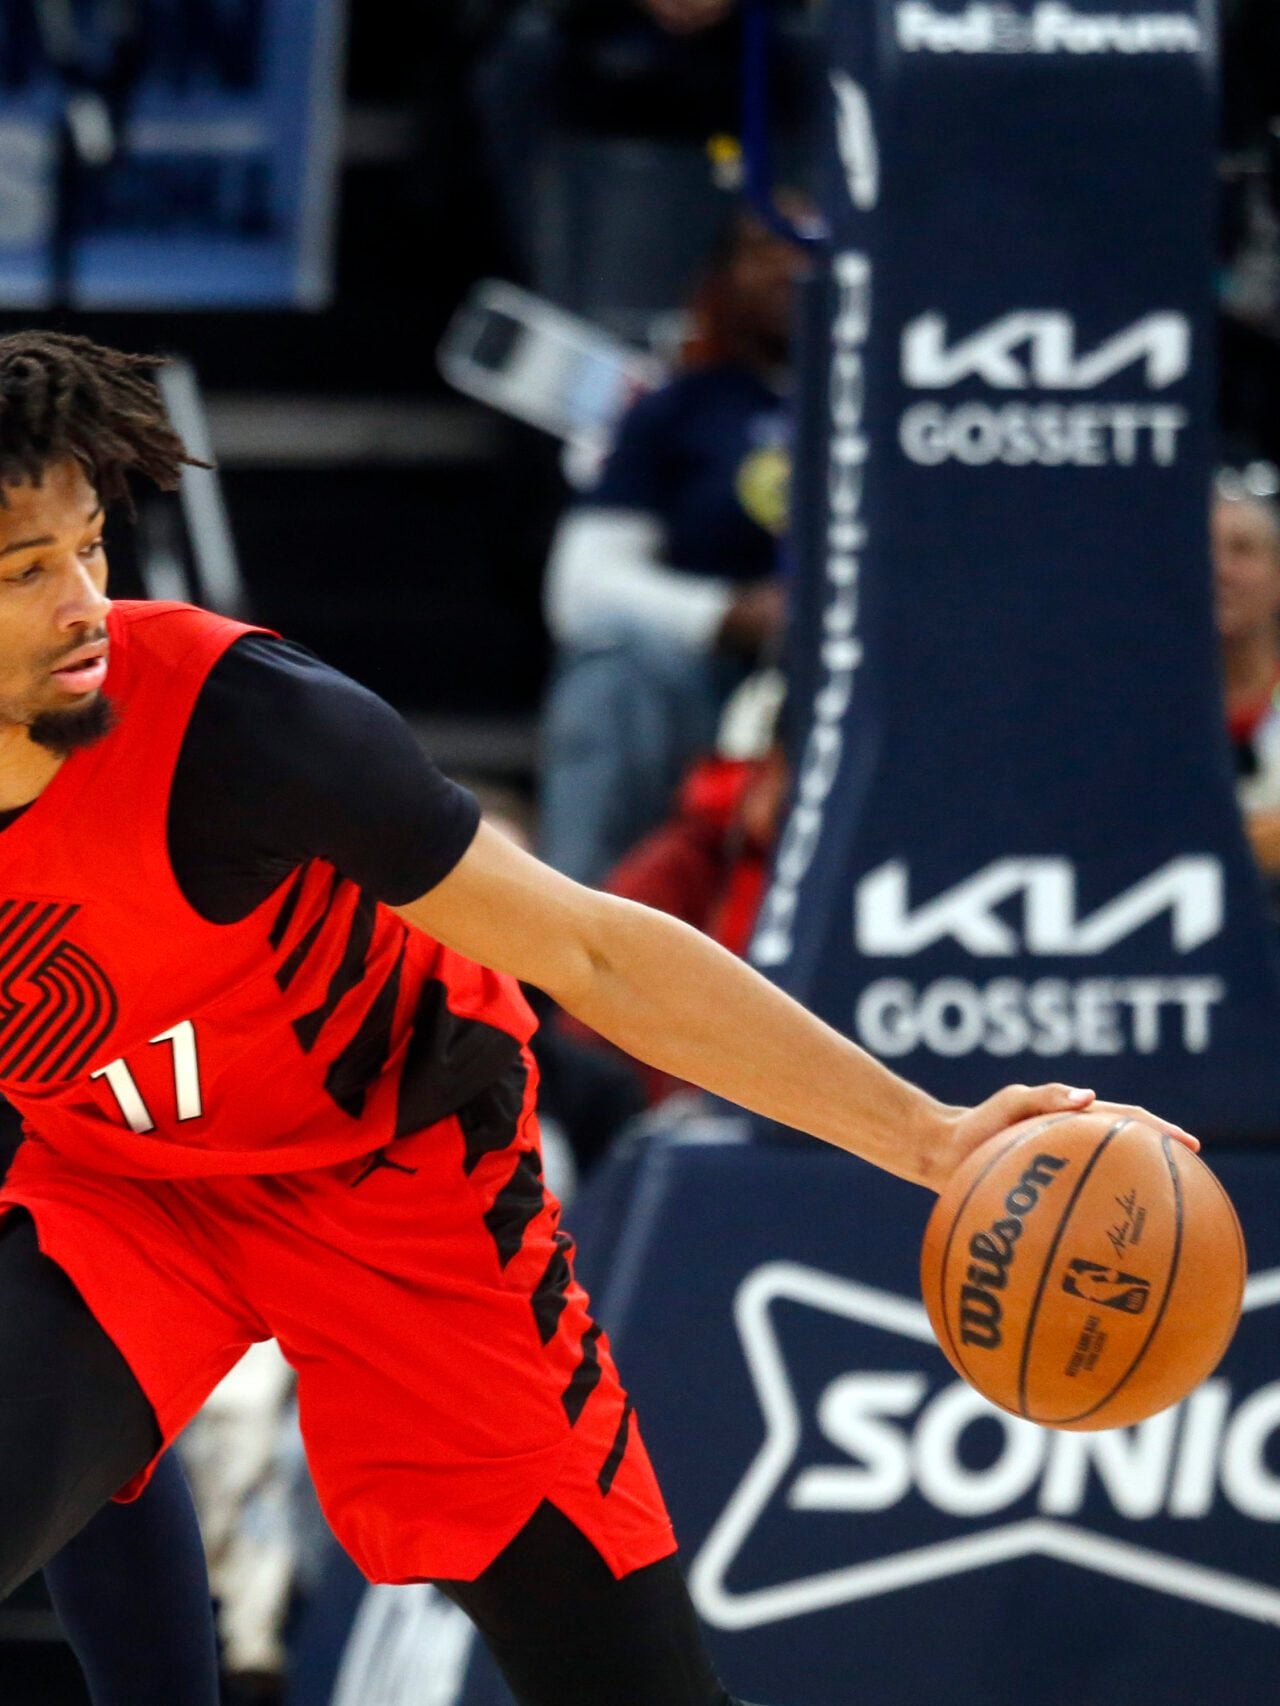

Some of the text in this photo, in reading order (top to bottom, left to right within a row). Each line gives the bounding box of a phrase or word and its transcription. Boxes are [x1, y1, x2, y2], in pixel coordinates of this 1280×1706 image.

[900, 308, 1191, 389] KIA
[899, 402, 1187, 466] GOSSETT
[854, 853, 1226, 957] KIA
[855, 976, 1226, 1058] GOSSETT
[90, 1019, 203, 1135] 17
[959, 1153, 1070, 1350] Wilson
